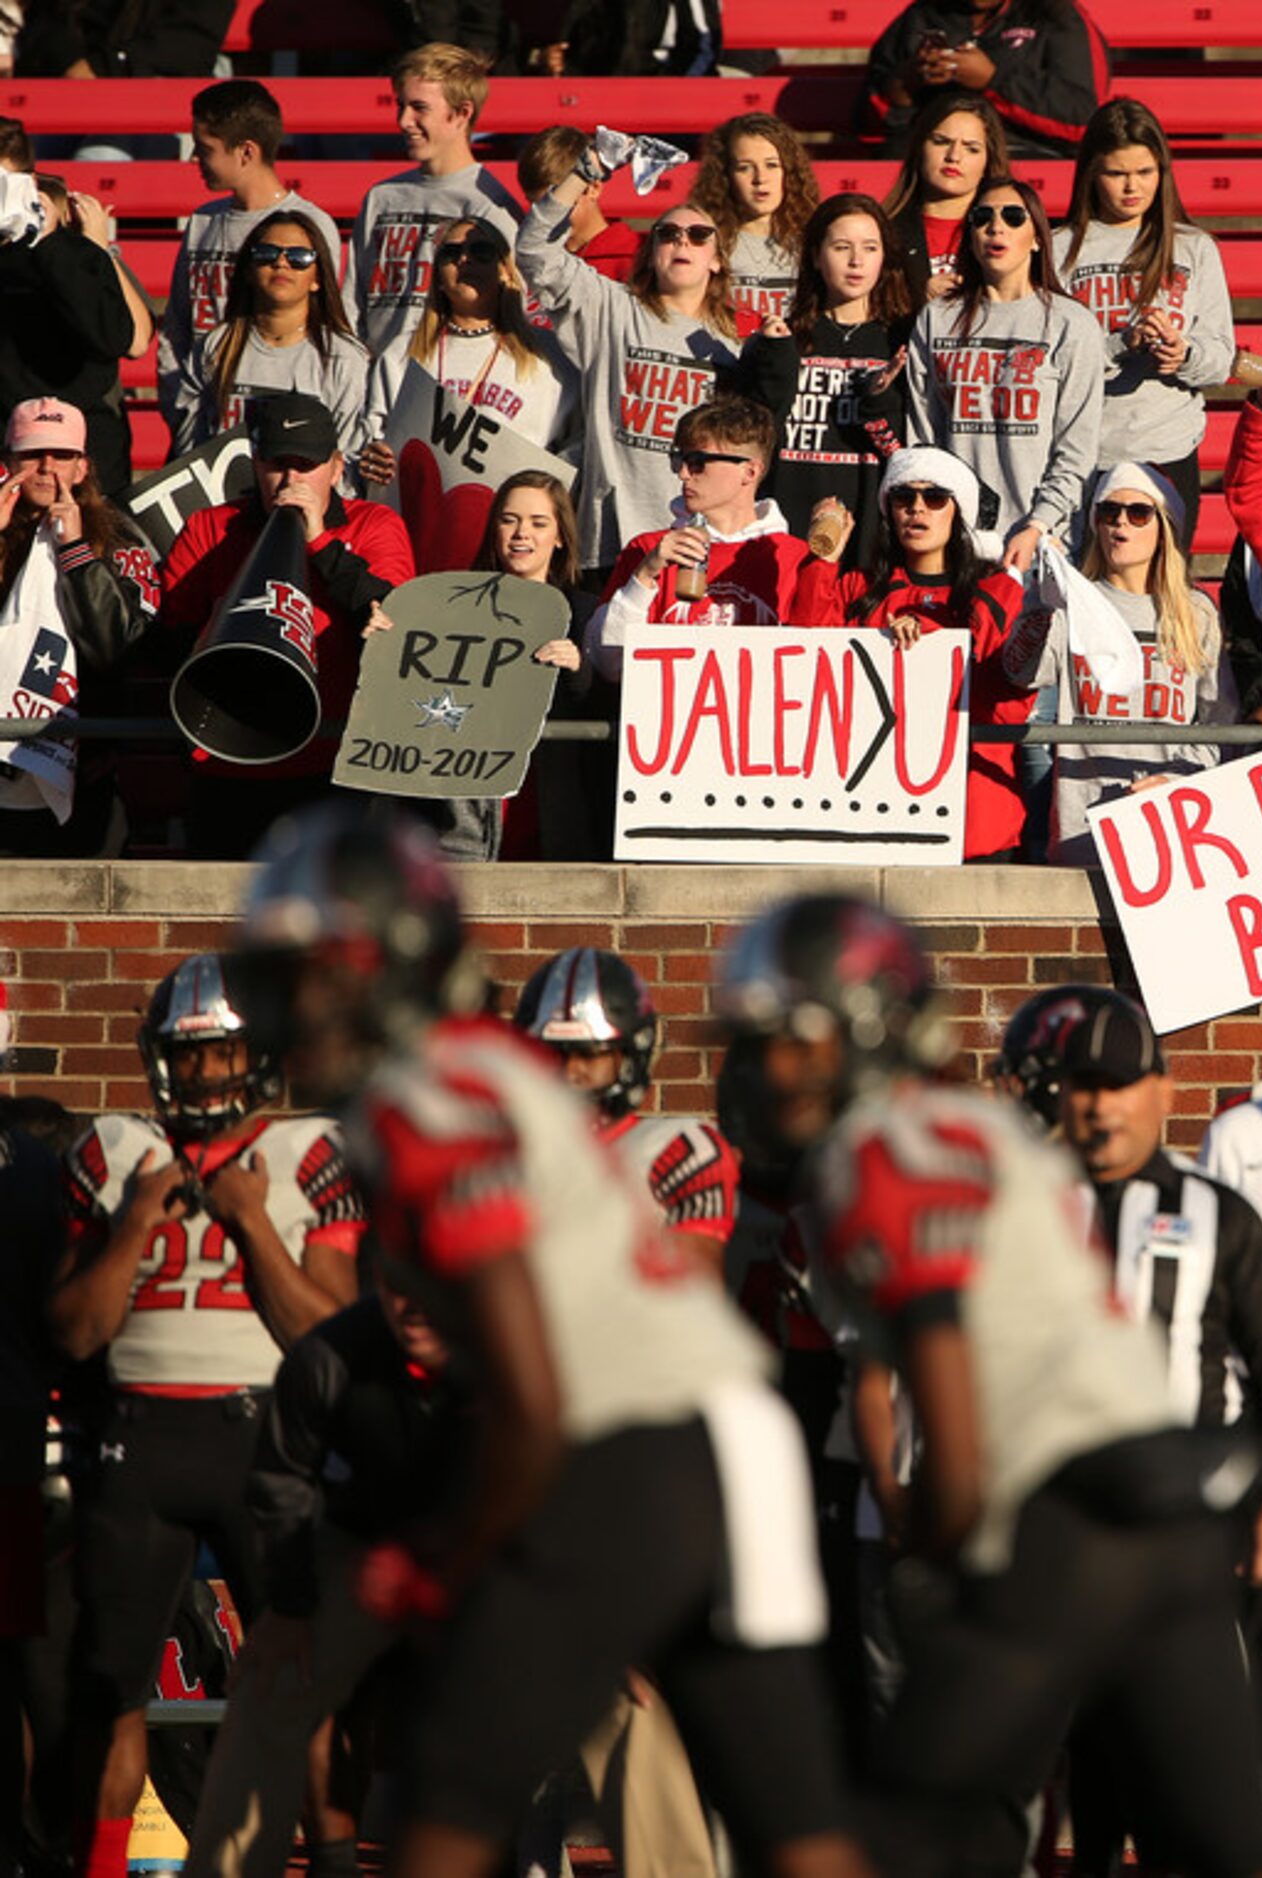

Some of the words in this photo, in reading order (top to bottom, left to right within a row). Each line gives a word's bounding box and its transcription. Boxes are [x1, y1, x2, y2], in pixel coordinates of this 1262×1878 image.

[624, 361, 709, 407] WHAT
[431, 385, 501, 475] WE
[620, 395, 679, 440] WE
[785, 422, 830, 451] YET
[399, 630, 526, 688] RIP
[347, 738, 515, 780] 2010-2017
[1098, 786, 1249, 908] UR
[131, 1217, 254, 1311] 22
